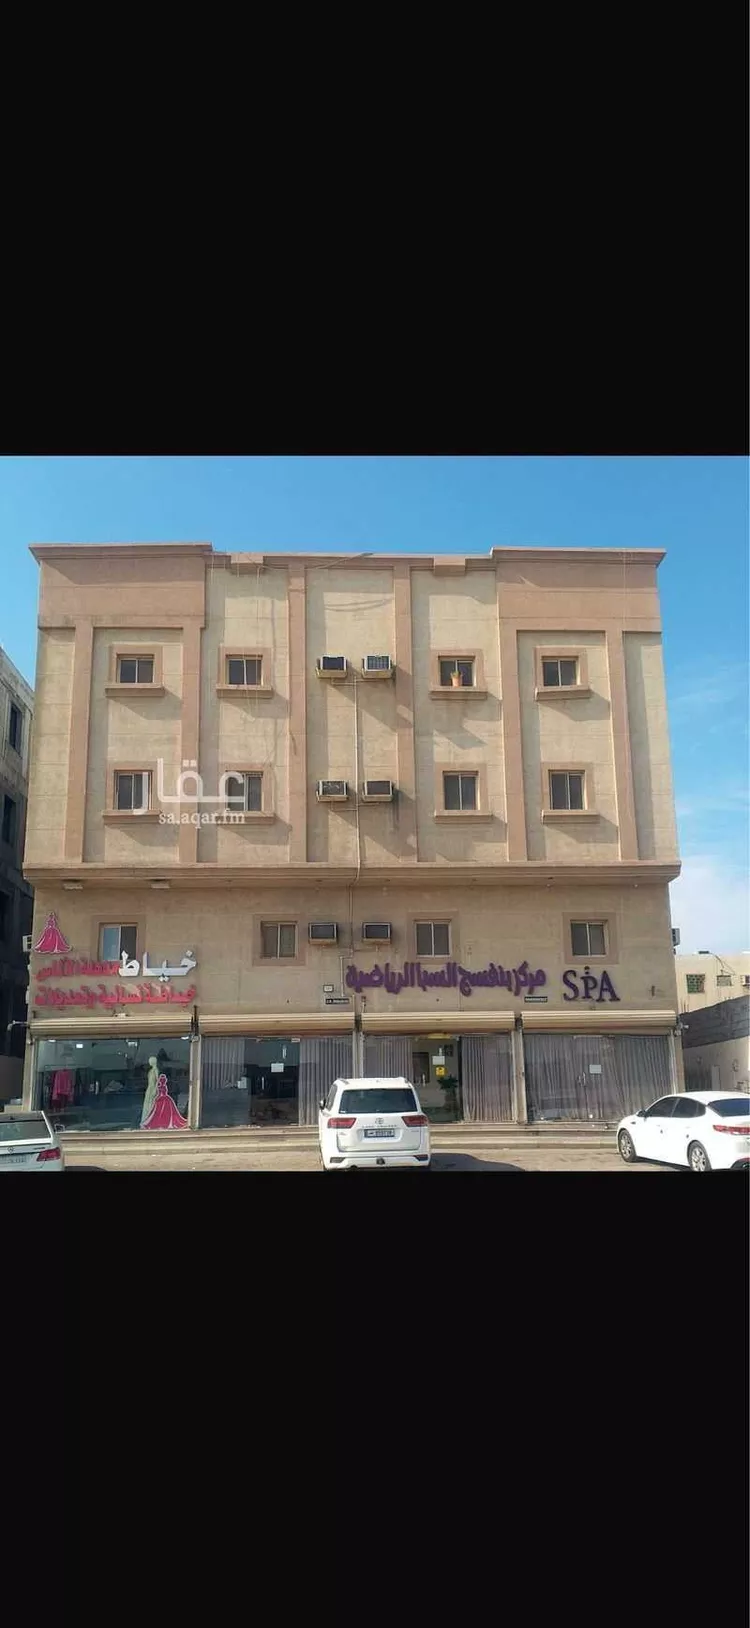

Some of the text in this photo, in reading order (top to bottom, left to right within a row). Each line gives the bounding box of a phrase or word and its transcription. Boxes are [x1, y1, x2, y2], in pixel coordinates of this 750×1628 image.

[118, 950, 197, 982] خياط
[345, 962, 414, 995] الرياضية
[458, 963, 513, 997] بنفسج
[512, 961, 547, 996] مركز
[562, 966, 621, 1002] SPA
